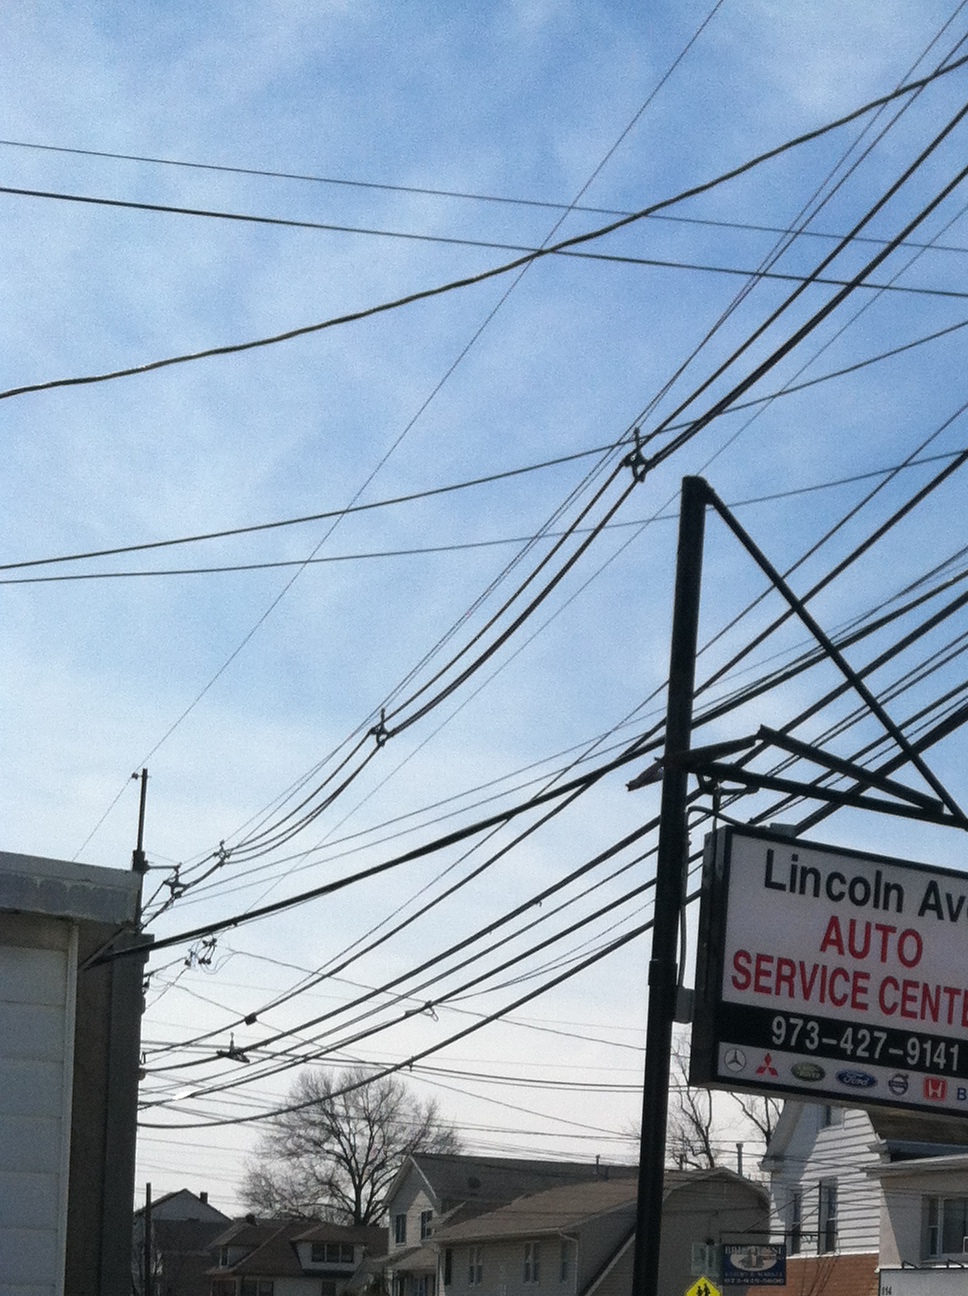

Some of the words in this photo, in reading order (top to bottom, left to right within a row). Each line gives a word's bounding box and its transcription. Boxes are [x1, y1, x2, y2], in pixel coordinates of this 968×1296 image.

[764, 848, 905, 914] Lincoln
[820, 915, 923, 968] AUTO
[731, 949, 871, 1011] SERVICE
[771, 1016, 959, 1071] 973-427-9141
